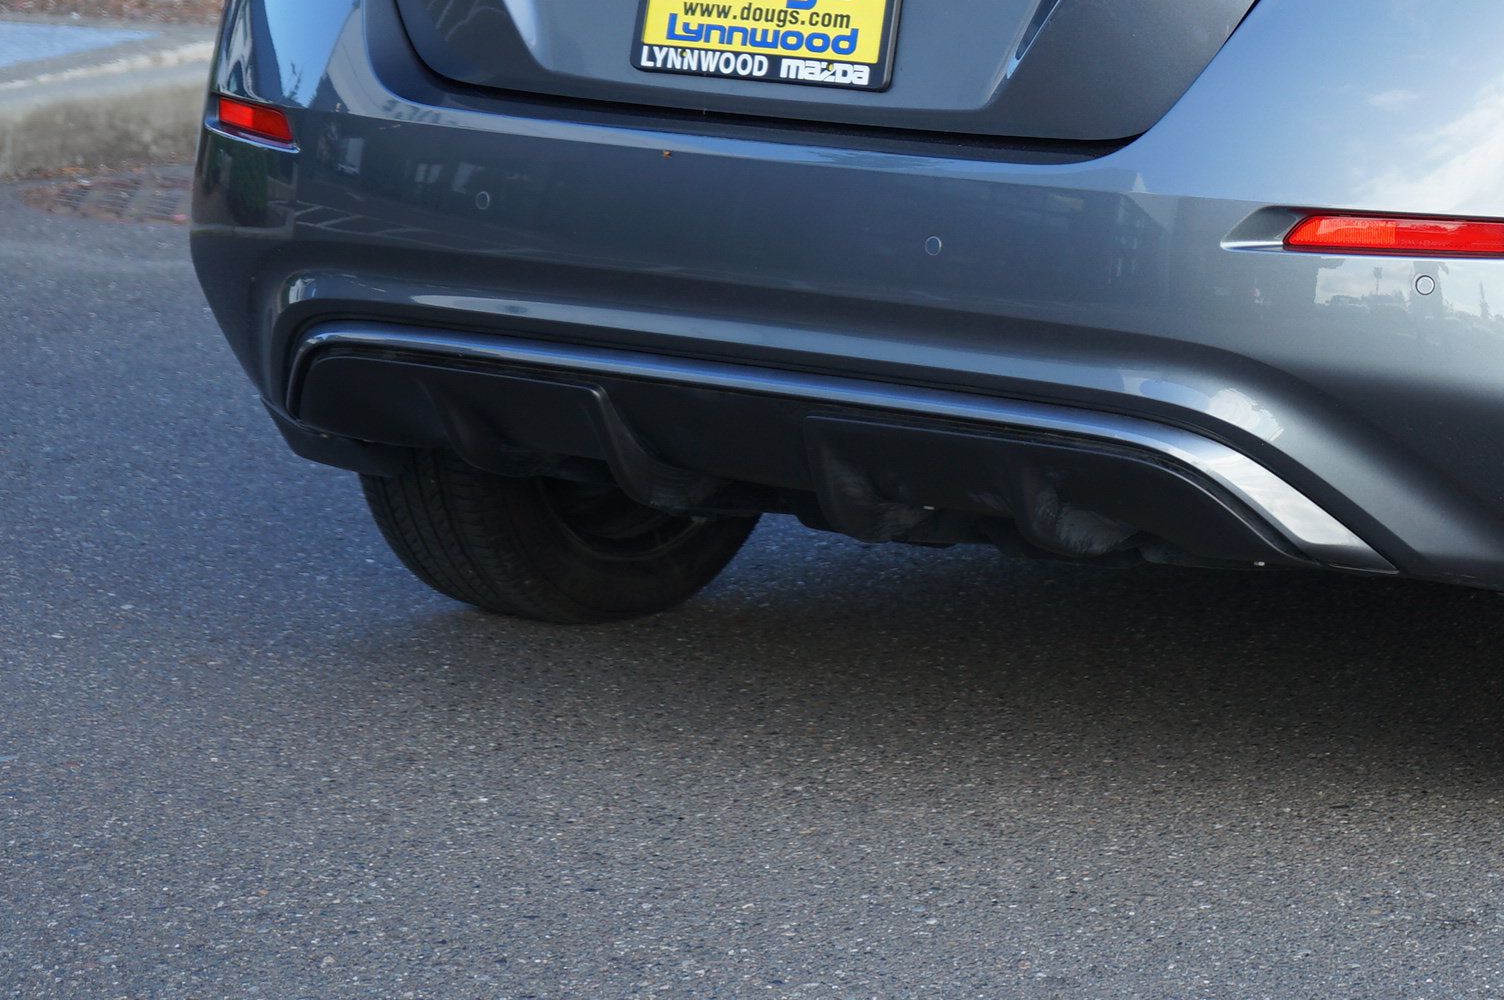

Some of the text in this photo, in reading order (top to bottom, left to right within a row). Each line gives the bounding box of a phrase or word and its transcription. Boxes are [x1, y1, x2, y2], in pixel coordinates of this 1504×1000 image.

[683, 1, 851, 28] www.dougs.com
[666, 13, 859, 55] Lynnwood
[640, 45, 769, 77] LYNNWOOD
